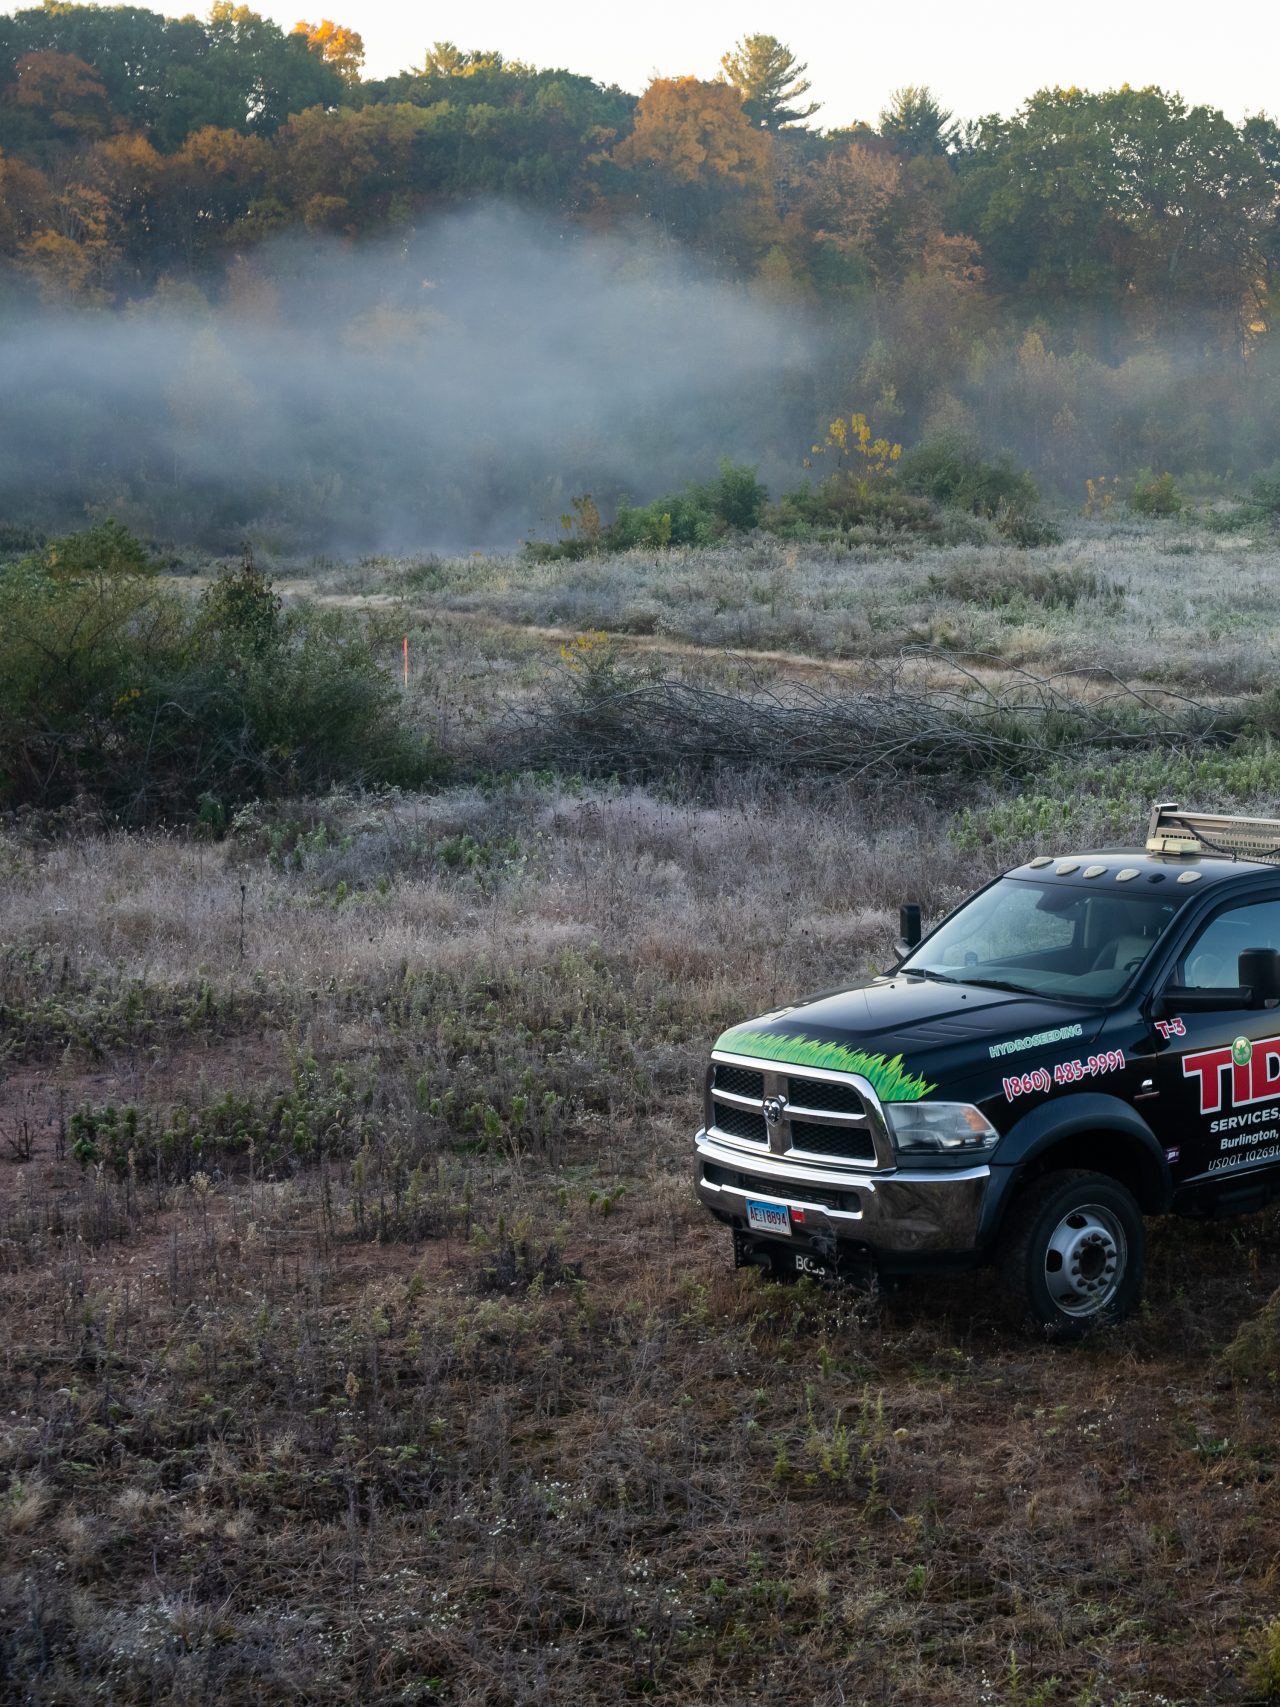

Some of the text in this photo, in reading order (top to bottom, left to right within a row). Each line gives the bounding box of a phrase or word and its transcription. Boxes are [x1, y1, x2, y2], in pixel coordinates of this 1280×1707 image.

[1154, 1017, 1187, 1039] T-3
[989, 1023, 1083, 1058] HYDROSEEDING
[1002, 1049, 1125, 1103] (860) 485-9991
[1220, 1129, 1279, 1150] Burlington,
[1208, 1153, 1243, 1171] USDOT
